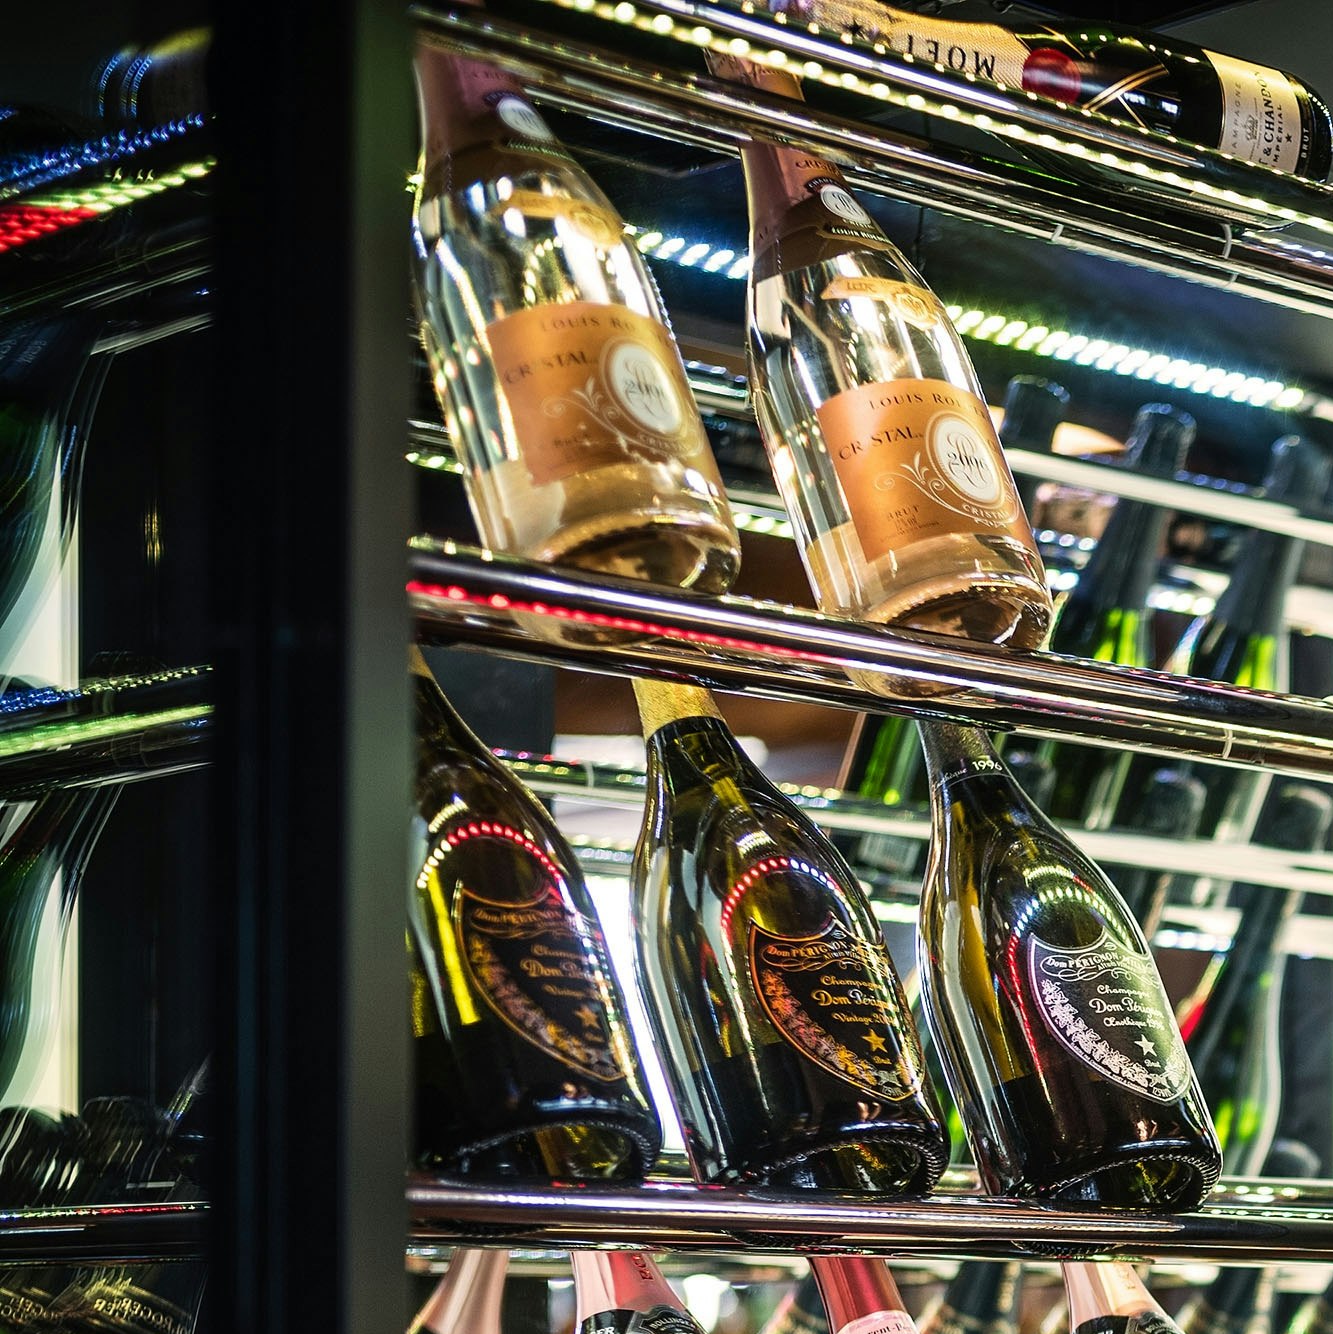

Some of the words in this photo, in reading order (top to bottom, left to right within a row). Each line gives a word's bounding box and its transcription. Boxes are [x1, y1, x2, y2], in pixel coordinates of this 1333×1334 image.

[1229, 82, 1242, 154] AMPAGNE
[1301, 127, 1310, 158] BRUT
[1262, 147, 1272, 156] &
[541, 316, 601, 333] LOUIS
[504, 351, 590, 385] CRSTAL
[869, 392, 923, 411] LOUIS
[839, 426, 917, 460] CRSTAL
[972, 760, 1003, 771] 1996
[767, 944, 791, 957] Dom
[1046, 956, 1067, 968] Dom
[811, 989, 851, 1007] Dom
[1089, 998, 1124, 1014] Dom
